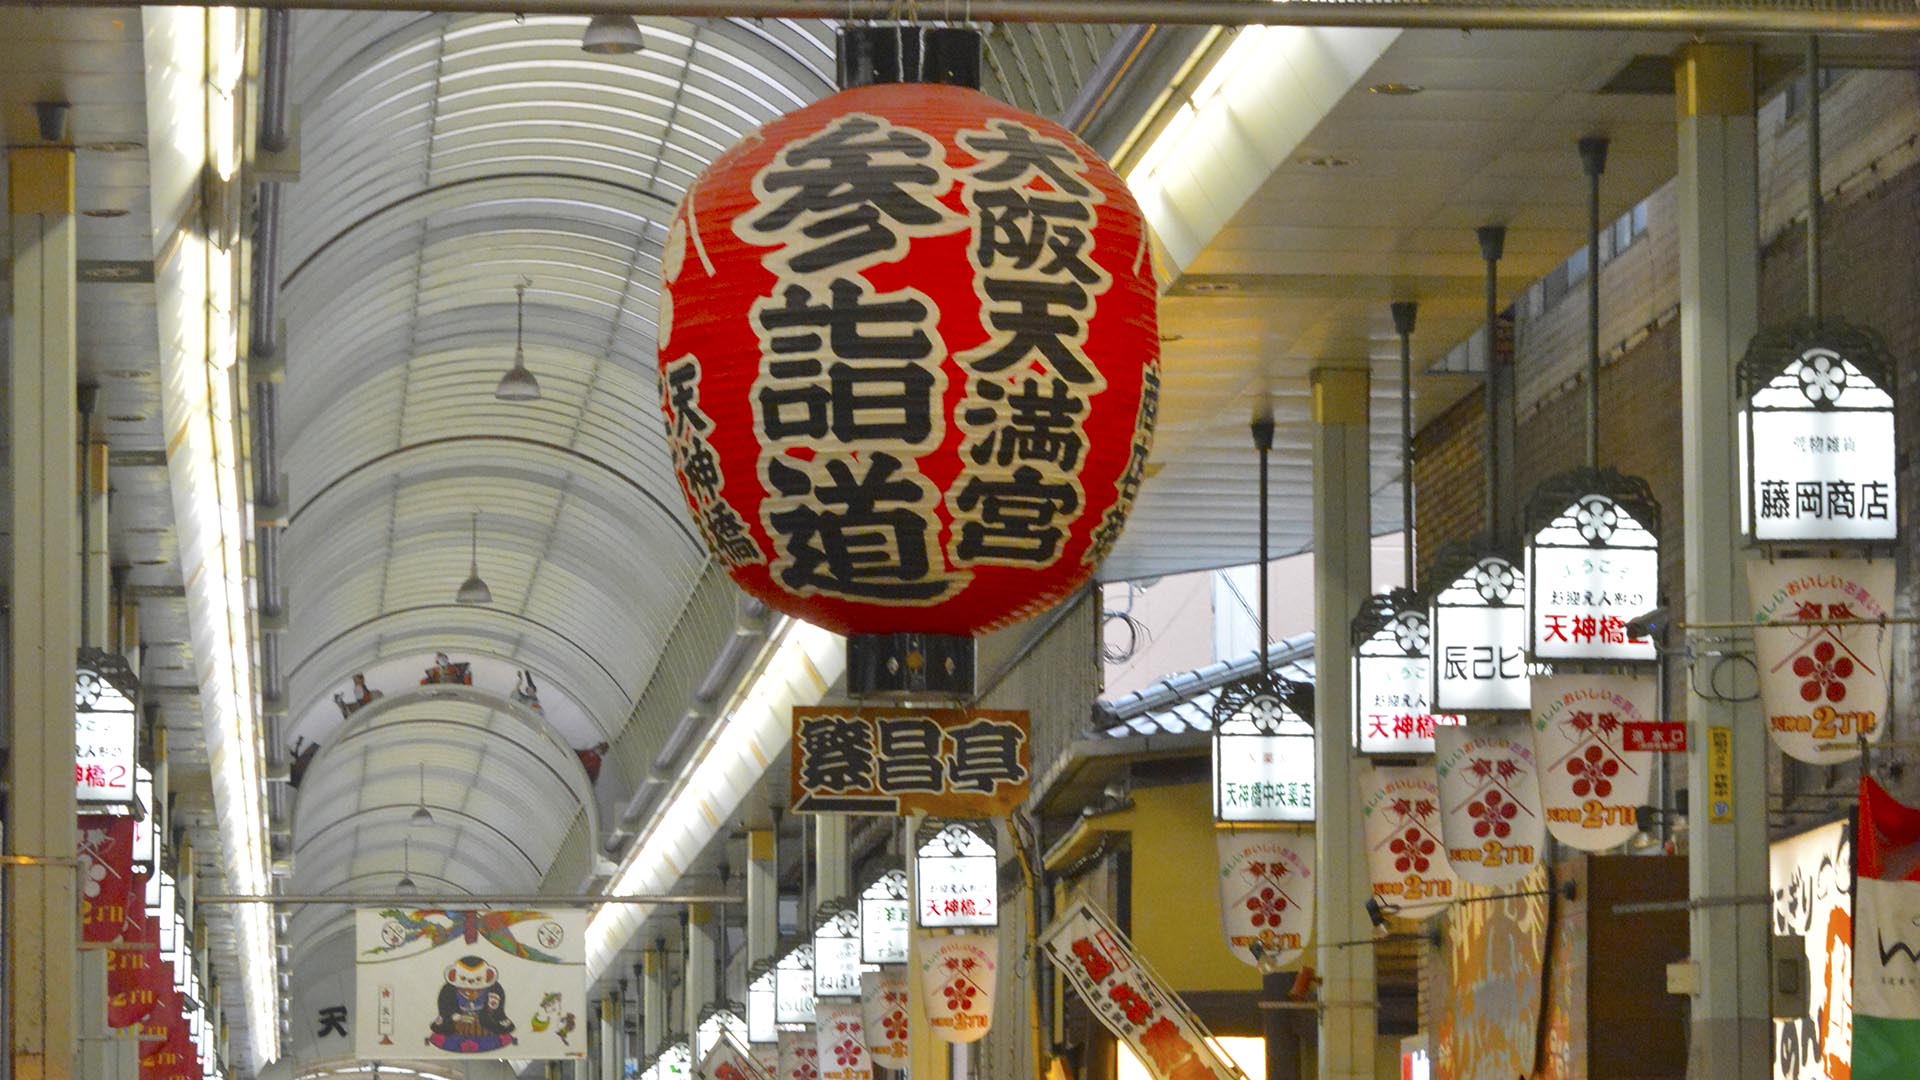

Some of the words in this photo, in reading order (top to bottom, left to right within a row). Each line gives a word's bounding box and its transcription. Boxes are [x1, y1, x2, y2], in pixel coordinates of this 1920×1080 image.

[749, 114, 955, 604] 参詣道
[957, 124, 1104, 563] 大阪天満宮
[1760, 479, 1889, 520] 藤岡商店
[1544, 614, 1648, 644] 天神橋
[800, 717, 1027, 796] 繁昌亭
[317, 1006, 348, 1038] 天
